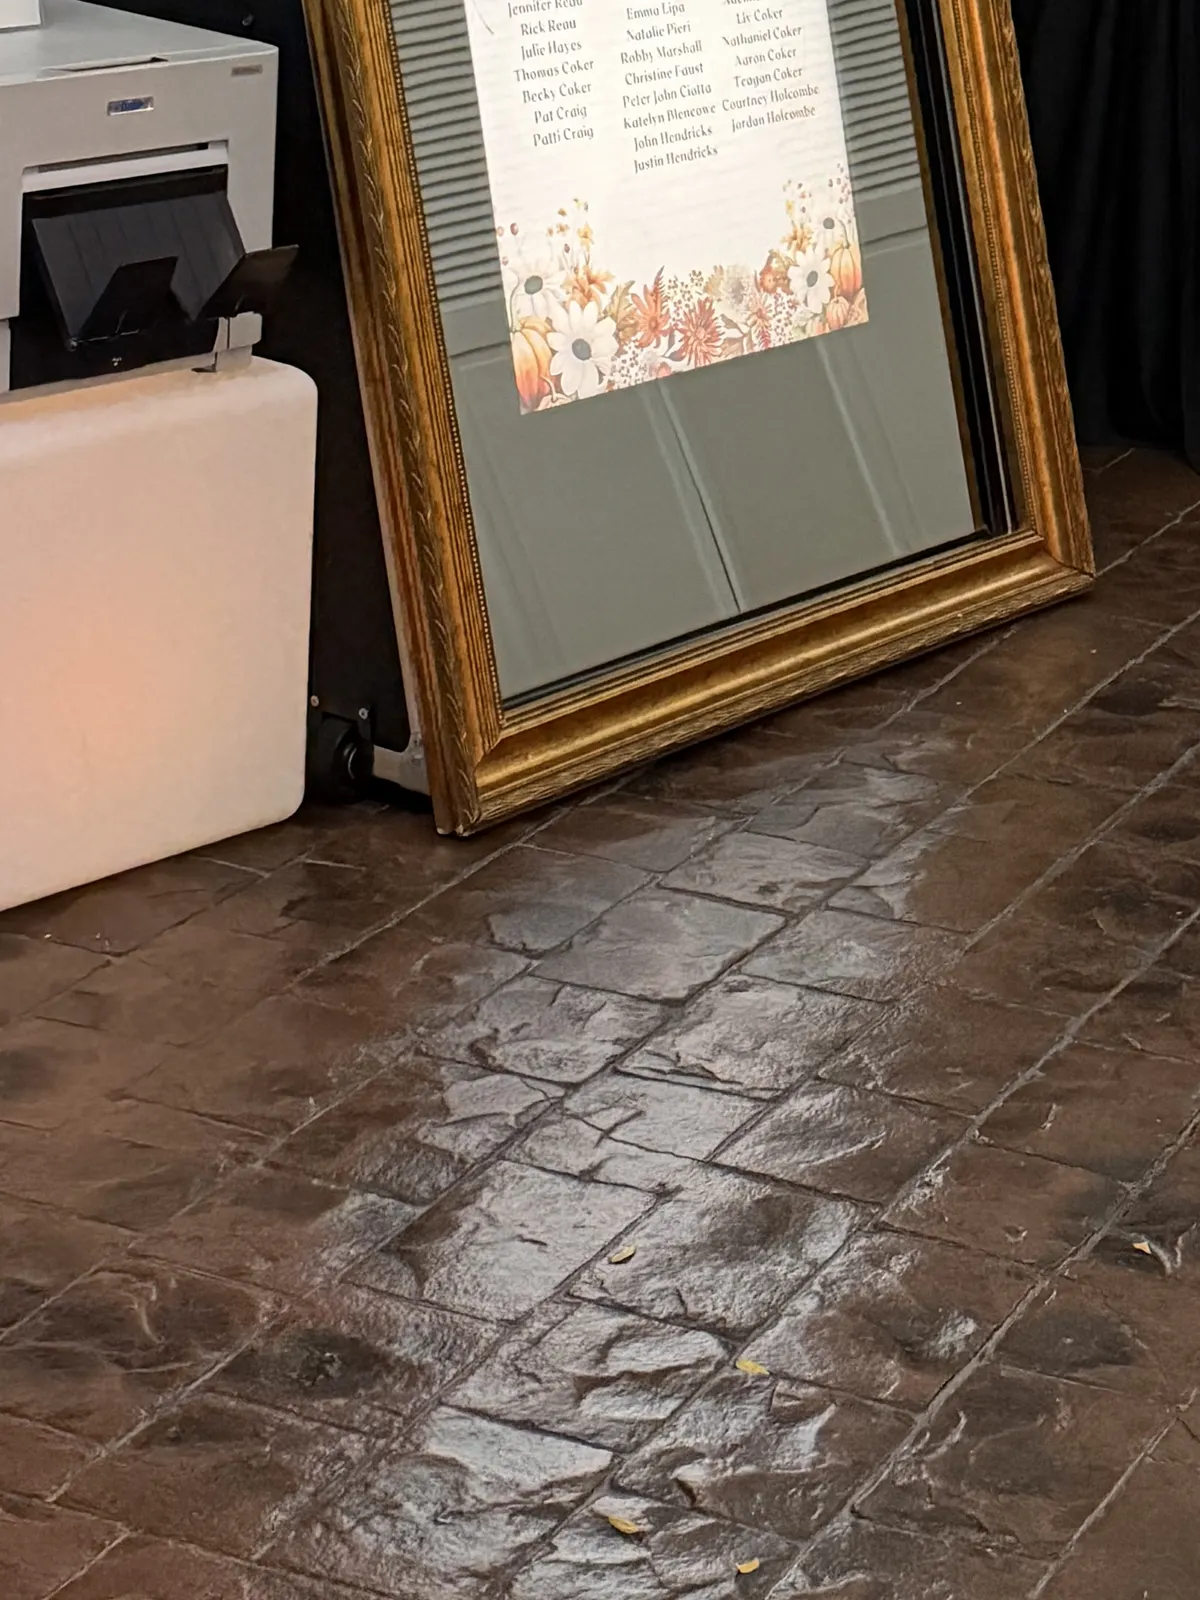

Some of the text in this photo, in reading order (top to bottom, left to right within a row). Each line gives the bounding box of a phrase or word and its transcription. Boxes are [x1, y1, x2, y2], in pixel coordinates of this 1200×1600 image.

[754, 8, 783, 22] Coker
[521, 22, 546, 36] Rick
[773, 26, 802, 40] Coker
[521, 40, 582, 61] Julie Hayes
[768, 48, 797, 62] Coker
[514, 60, 594, 83] Thomas Coker
[774, 67, 802, 82] Coker
[523, 82, 592, 103] Becky Coker
[535, 105, 587, 124] Pat Craig
[533, 126, 594, 147] Patti Craig
